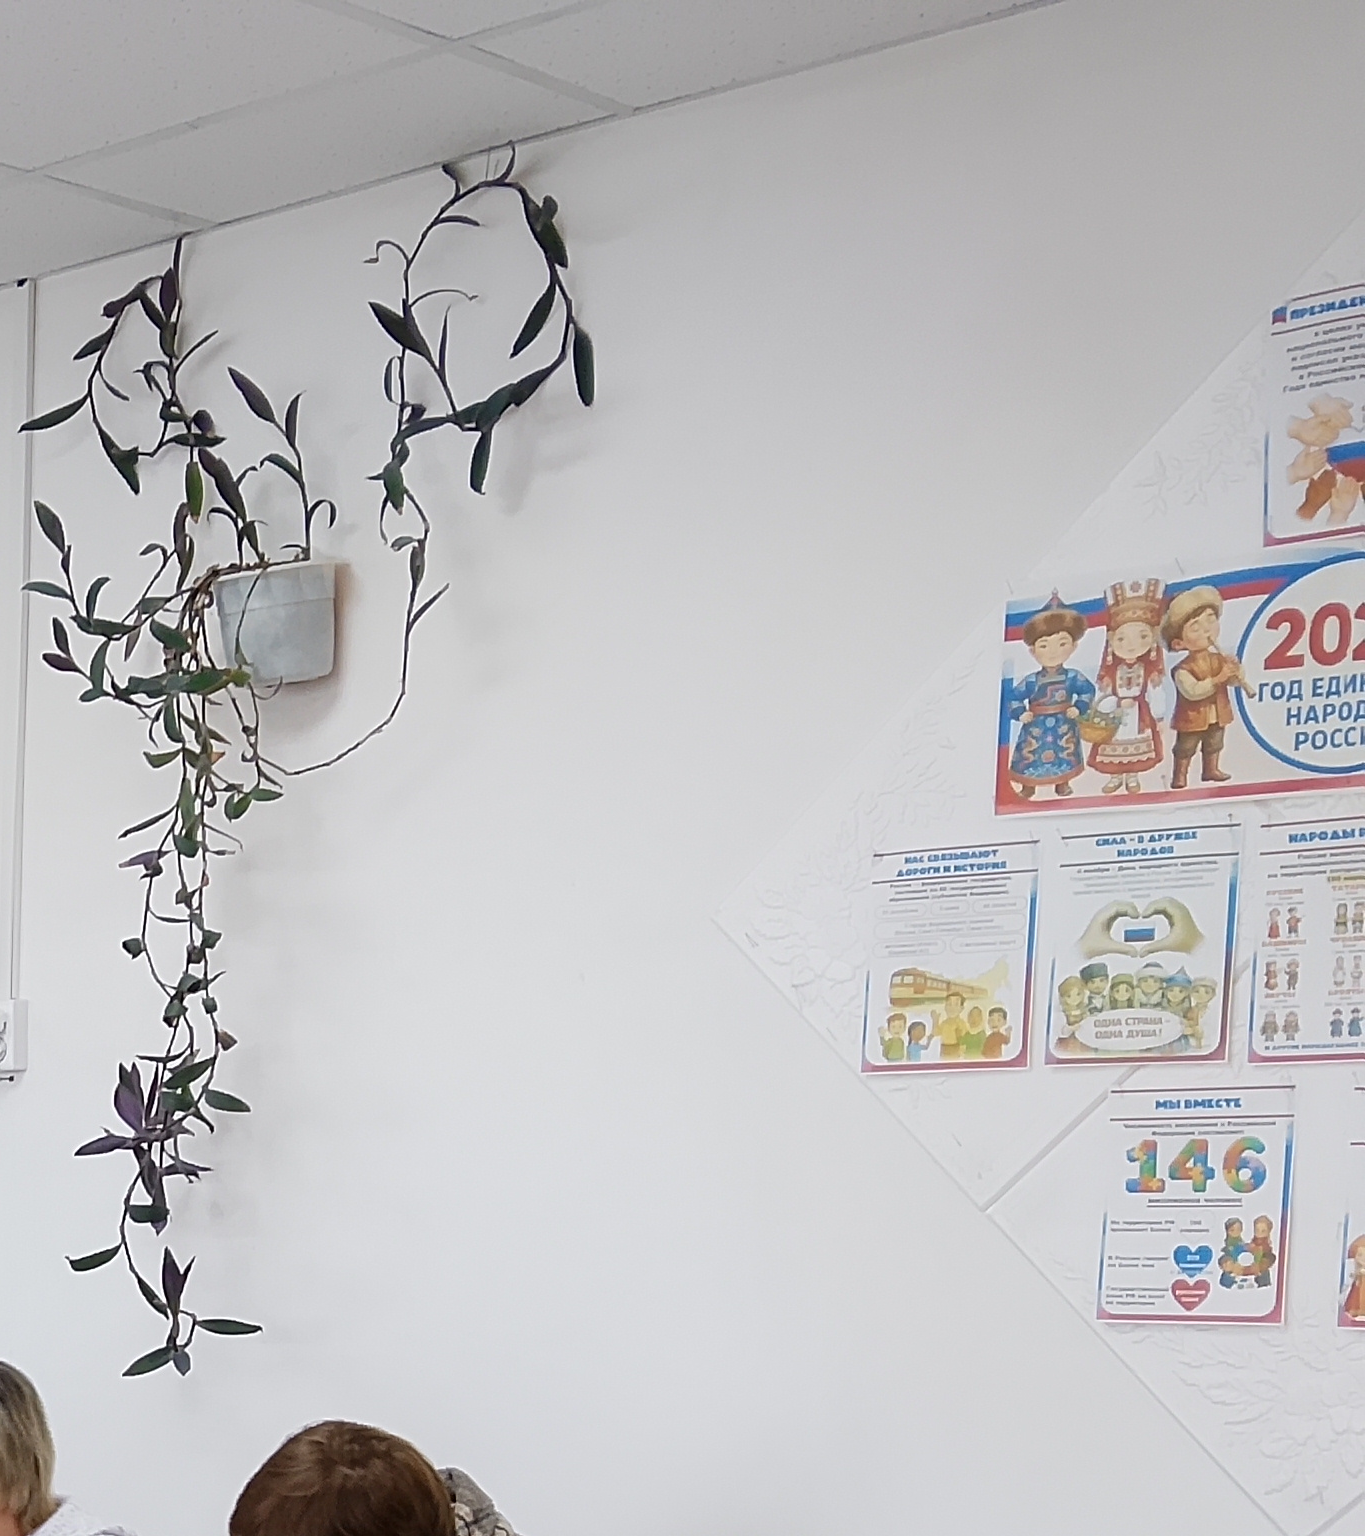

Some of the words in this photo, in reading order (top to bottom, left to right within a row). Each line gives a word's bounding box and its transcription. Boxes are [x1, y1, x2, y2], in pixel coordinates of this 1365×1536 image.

[1258, 679, 1303, 702] ГОД
[1288, 828, 1355, 843] НАРОДЫ
[1117, 846, 1175, 858] НАРОДОВ
[904, 855, 925, 864] НАС
[896, 866, 941, 878] ДОРОГИ
[1094, 1017, 1122, 1028] ОДНА
[1095, 1030, 1123, 1039] ОДНА
[1155, 1099, 1180, 1110] МЫ
[1184, 1098, 1242, 1110] ВМЕСТЕ
[1126, 1136, 1267, 1193] 146
